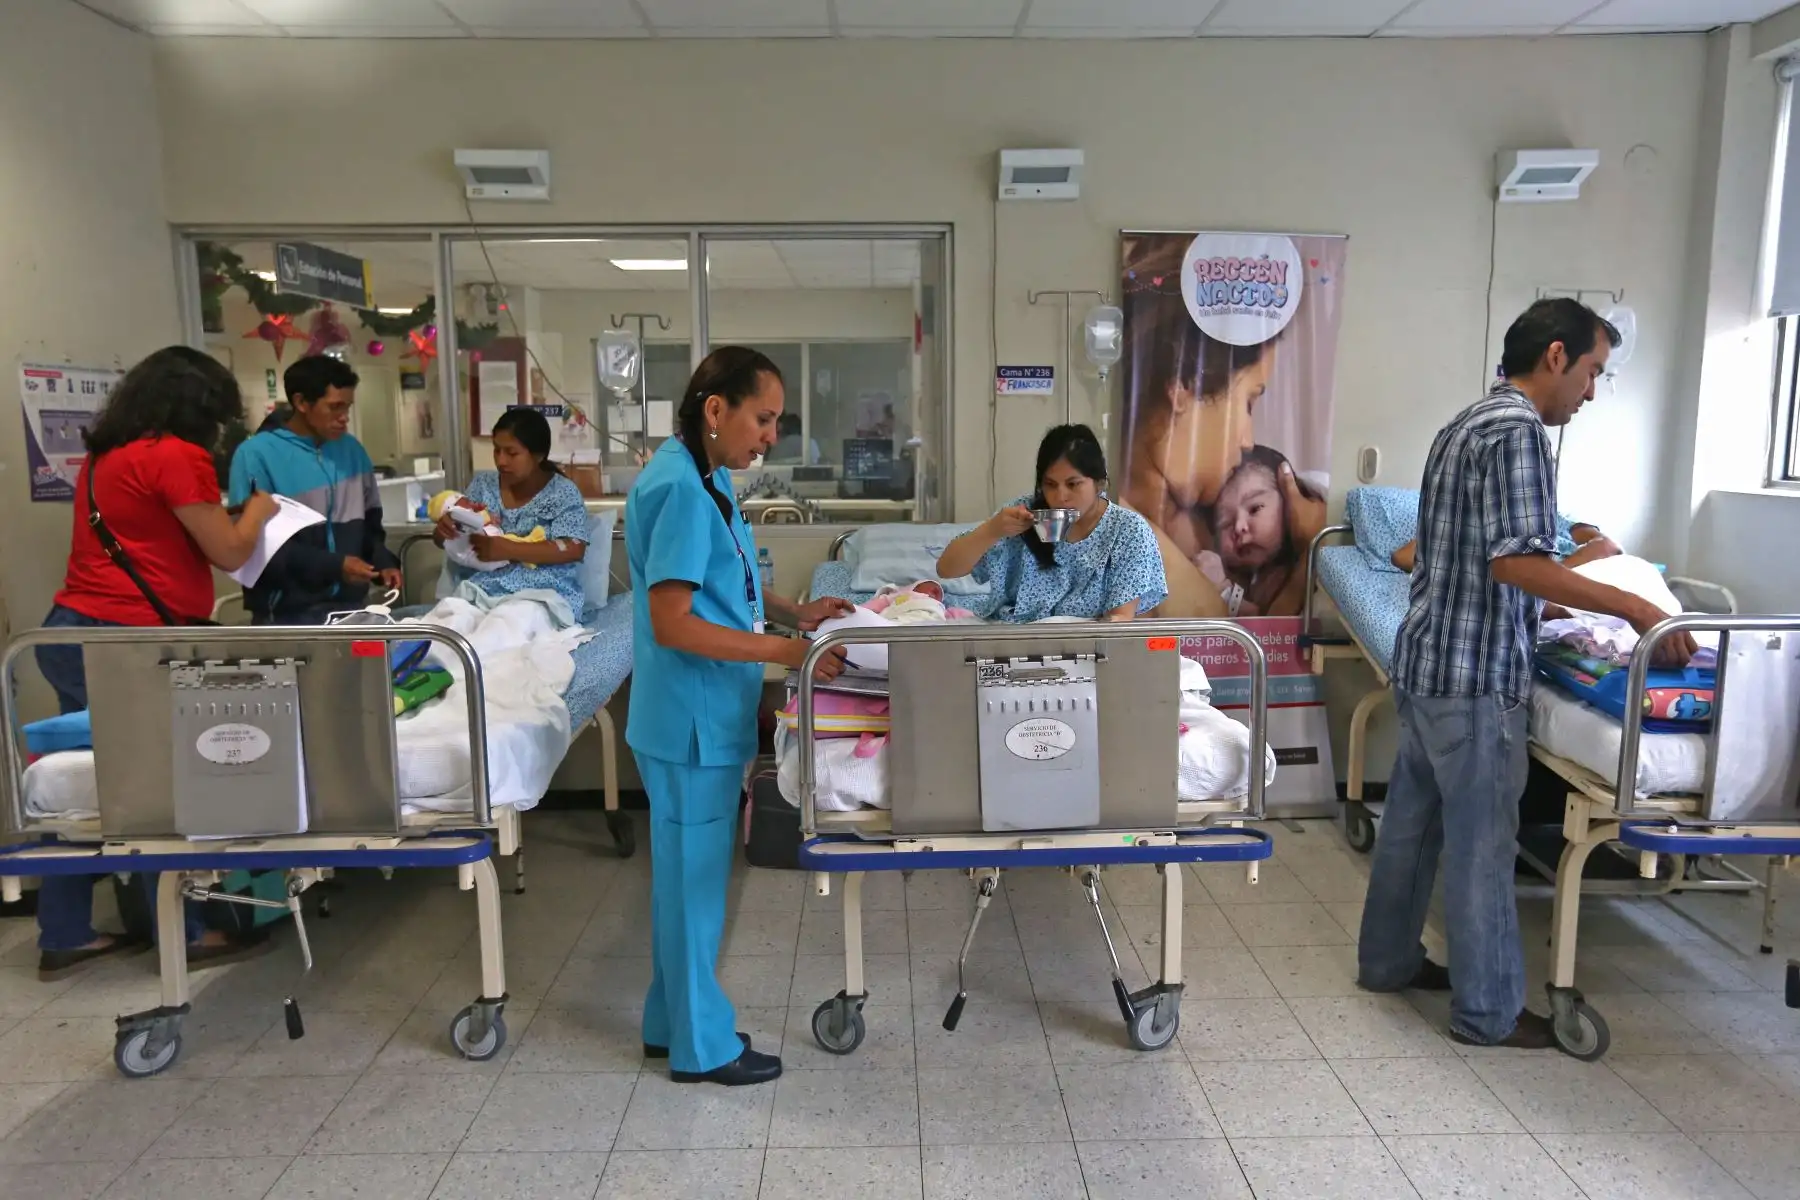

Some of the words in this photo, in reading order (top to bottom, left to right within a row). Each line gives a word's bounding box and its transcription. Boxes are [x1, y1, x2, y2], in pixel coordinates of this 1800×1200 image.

[1194, 254, 1288, 286] RECIÉN
[1002, 369, 1023, 377] Cama
[1036, 369, 1050, 377] 236
[1206, 635, 1234, 649] para
[226, 749, 241, 758] 237
[1034, 745, 1048, 753] 236
